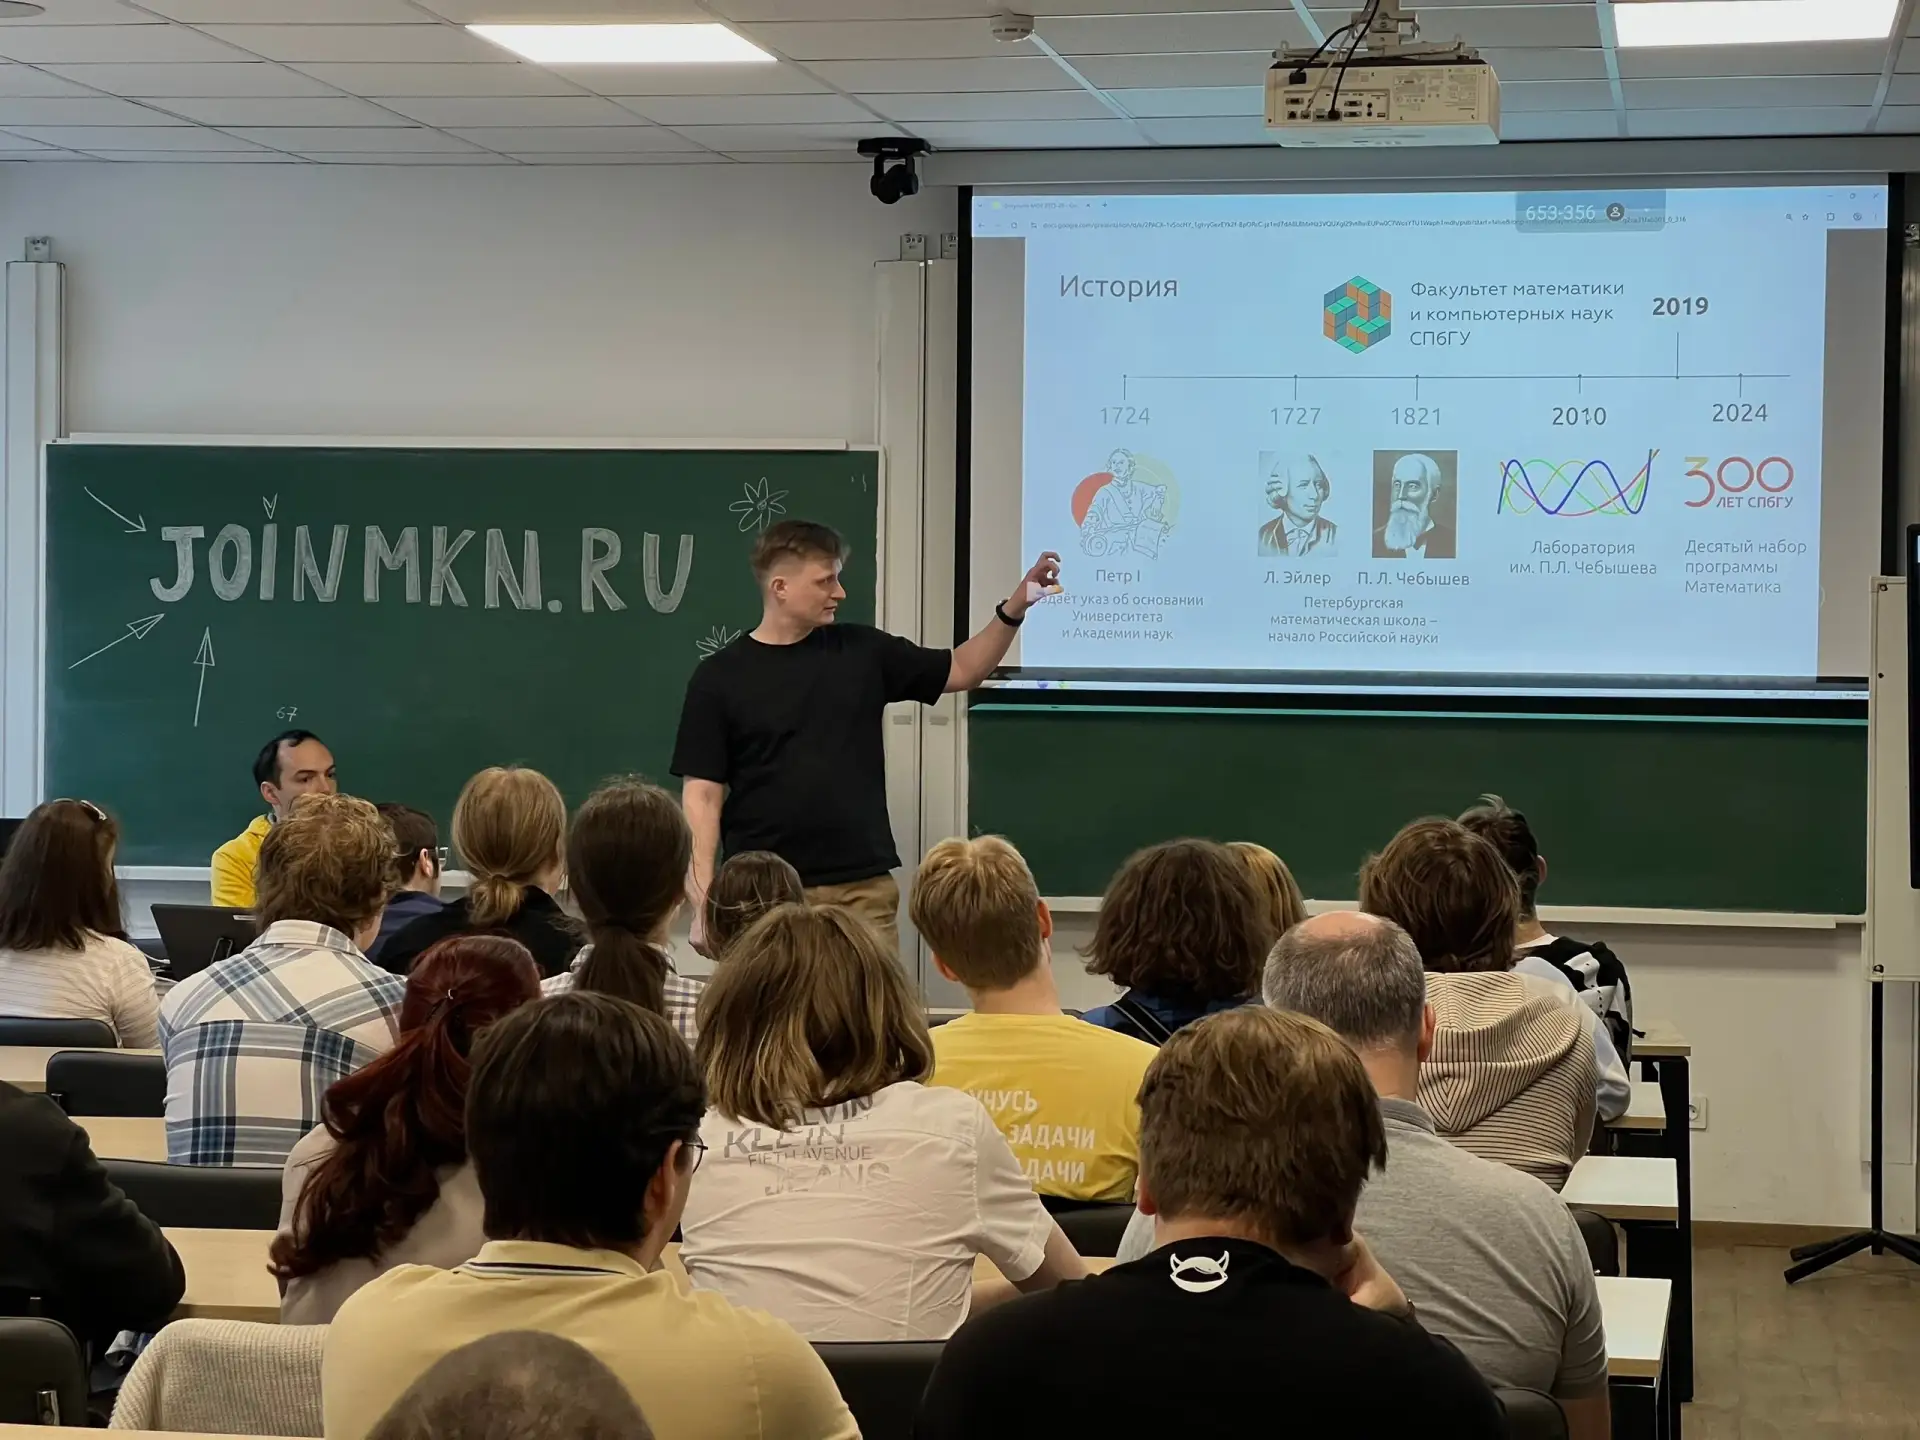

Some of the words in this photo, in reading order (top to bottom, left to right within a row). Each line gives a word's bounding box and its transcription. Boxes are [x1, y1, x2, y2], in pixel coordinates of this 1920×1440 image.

[1526, 205, 1596, 221] 653-356
[1060, 274, 1178, 303] История
[1410, 282, 1508, 300] Факультет
[1513, 282, 1625, 297] математики
[1410, 311, 1421, 322] и
[1427, 308, 1565, 324] компьютерных
[1571, 306, 1614, 321] наук
[1652, 297, 1709, 317] 2019
[1409, 331, 1471, 346] СПбГУ
[1100, 407, 1150, 426] 1724
[1270, 407, 1321, 426] 1727
[1391, 407, 1442, 426] 1821
[1552, 407, 1607, 426] 2010
[1711, 404, 1768, 423] 2024
[1684, 456, 1794, 508] 300
[1716, 497, 1744, 508] ЛЕТ
[1747, 496, 1794, 509] СПбГУ
[1531, 540, 1636, 557] Лаборатория
[1684, 538, 1754, 556] Десятый
[1758, 538, 1807, 557] набор
[1510, 562, 1535, 574] им.
[1540, 560, 1571, 574] П.Л.
[1574, 560, 1657, 575] Чебышева
[1685, 561, 1778, 576] программы
[1096, 569, 1133, 585] Петр
[1264, 571, 1280, 584] Л.
[1283, 570, 1332, 587] Эйлер
[1357, 571, 1373, 585] П.
[1376, 571, 1392, 585] Л.
[1396, 571, 1470, 586] Чебышев
[1684, 580, 1781, 594] Математика
[1037, 592, 1078, 606] здаёт
[1080, 594, 1109, 608] указ
[1112, 593, 1129, 605] об
[1132, 596, 1204, 606] основании
[1304, 596, 1405, 611] Петербургская
[1072, 610, 1164, 625] Университета
[1270, 614, 1380, 626] математическая
[1383, 615, 1427, 628] школа
[1062, 629, 1070, 639] и
[1073, 627, 1141, 642] Академии
[1144, 630, 1174, 644] наук
[1268, 631, 1316, 643] начало
[1319, 630, 1396, 644] Российской
[1400, 633, 1439, 645] науки
[276, 705, 298, 722] 67
[1007, 1123, 1096, 1150] ЗАДАЧИ
[802, 1145, 873, 1162] AVENUE
